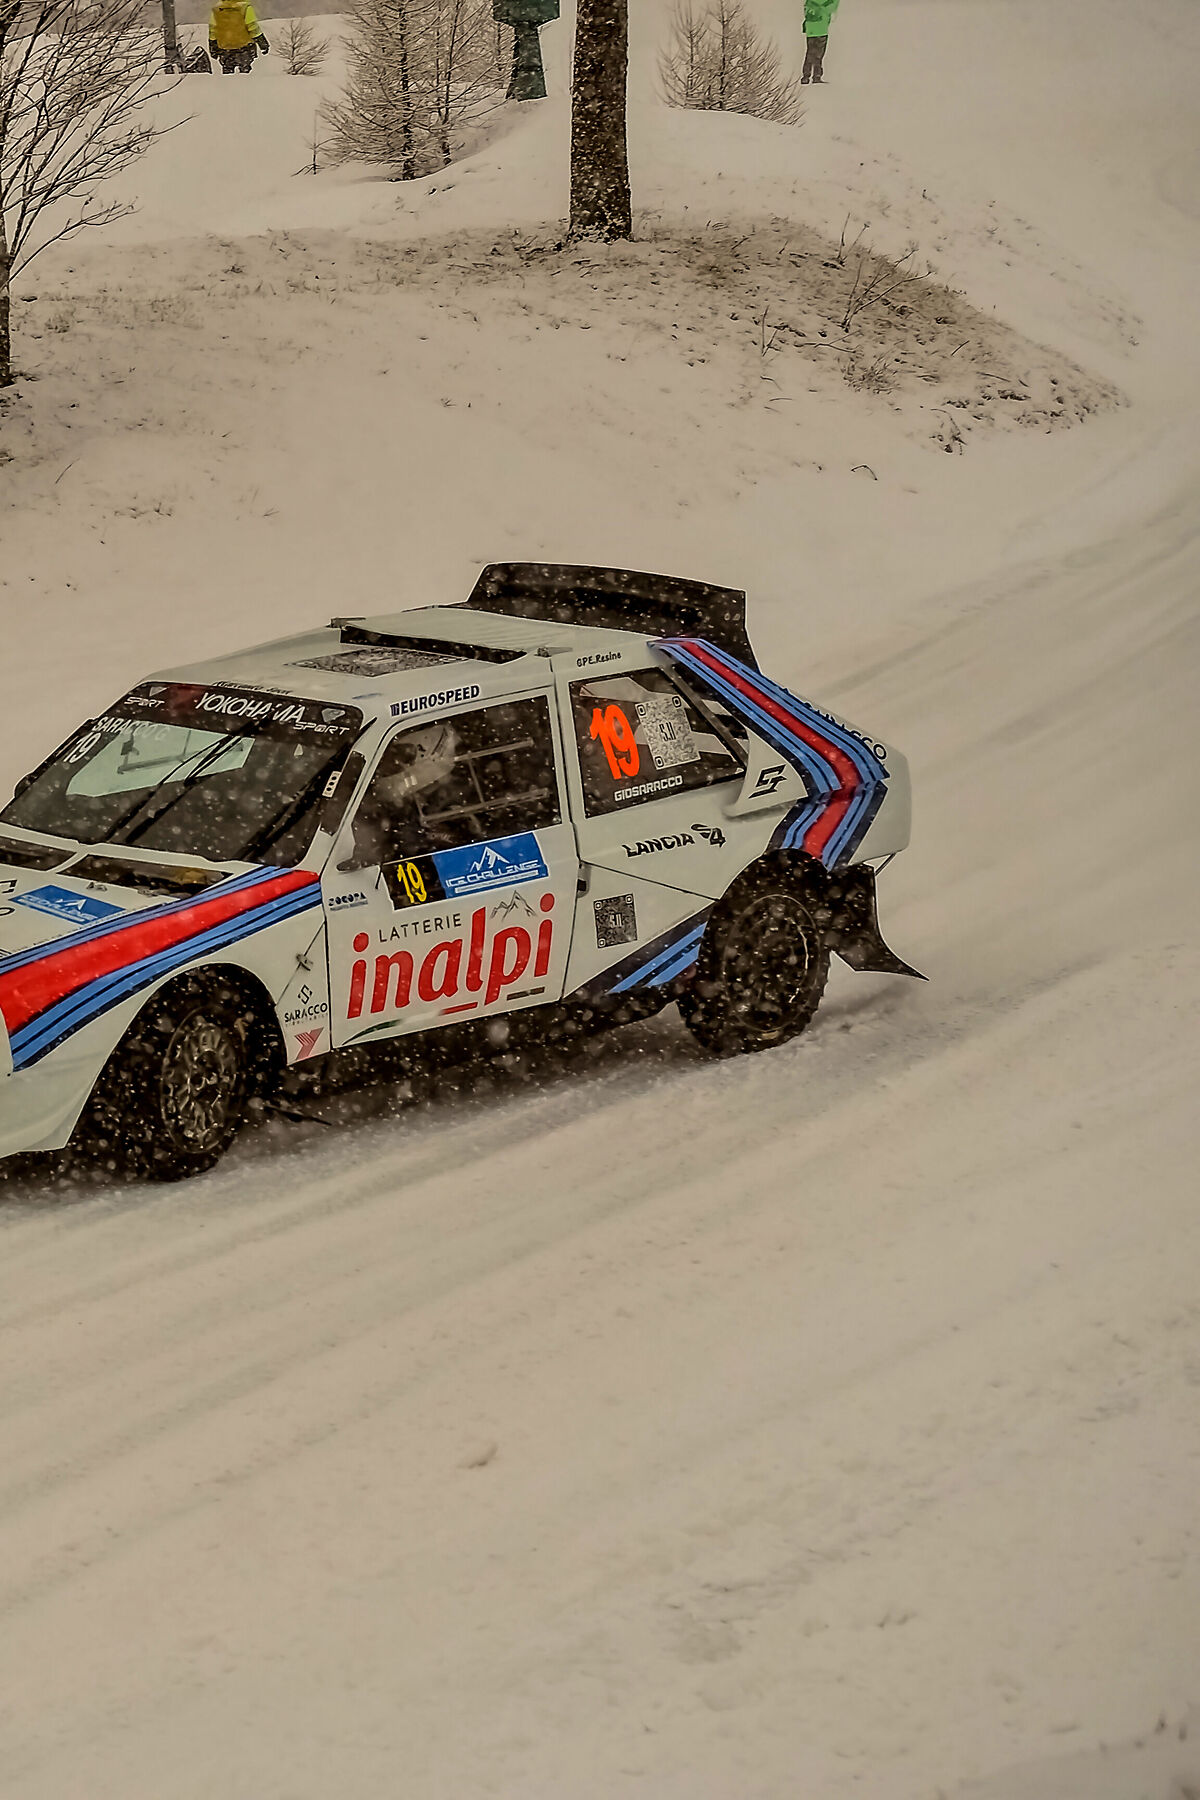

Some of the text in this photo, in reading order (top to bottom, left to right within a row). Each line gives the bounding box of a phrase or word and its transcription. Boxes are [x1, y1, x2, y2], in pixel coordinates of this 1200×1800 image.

[400, 684, 480, 715] EUROSPEED
[293, 721, 350, 736] SPORT
[589, 704, 640, 780] 19
[63, 731, 102, 764] 19
[622, 833, 695, 858] LANCIA
[396, 861, 428, 904] 19
[378, 913, 462, 943] LATTERIE
[347, 893, 556, 1020] inalpi
[284, 1002, 328, 1023] SARACCO
